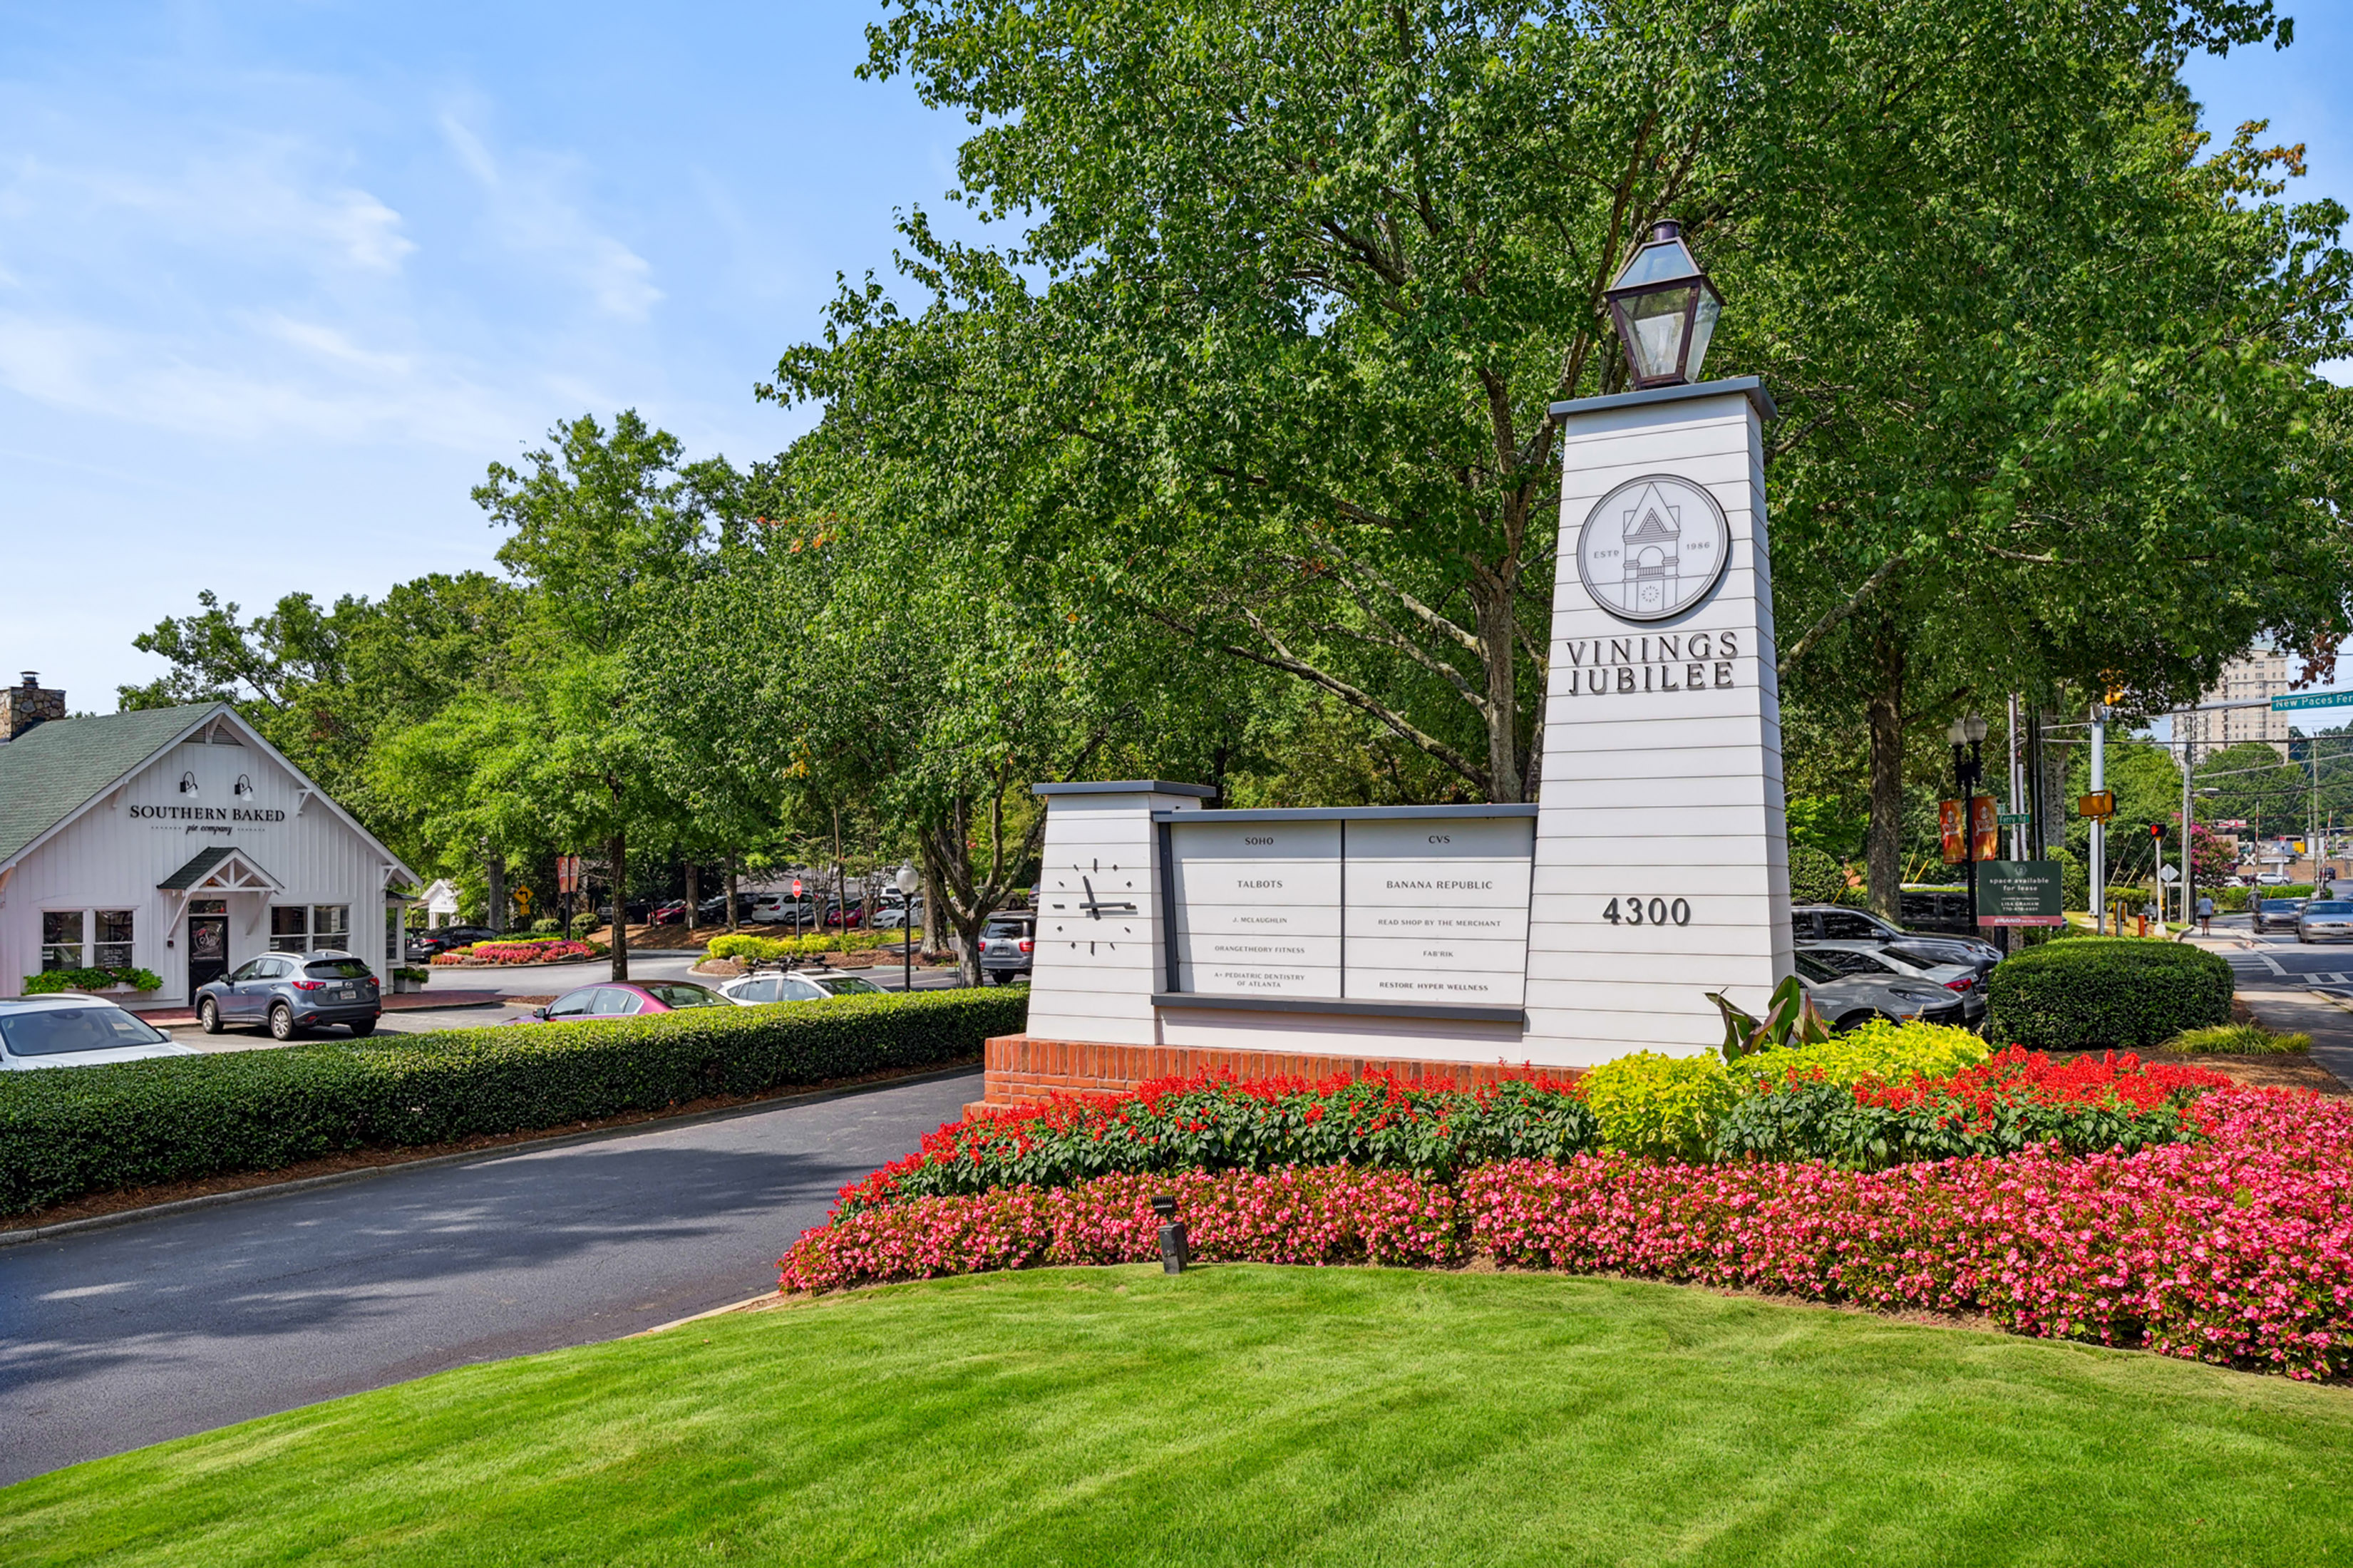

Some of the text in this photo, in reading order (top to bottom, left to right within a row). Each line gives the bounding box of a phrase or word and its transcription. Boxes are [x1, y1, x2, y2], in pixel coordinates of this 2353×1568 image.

[1686, 542, 1711, 550] 1986
[1567, 631, 1738, 666] VININGS
[1569, 661, 1734, 696] JUBILEE
[2275, 699, 2297, 708] New
[2302, 696, 2332, 706] Paces
[130, 805, 285, 822] SOUTHERN BAKED
[185, 824, 233, 835] pie company
[1245, 837, 1274, 845] SOHO
[1428, 835, 1451, 844] CVS
[1386, 880, 1493, 889] BANANA REPUBLIC
[1602, 897, 1692, 927] 4300
